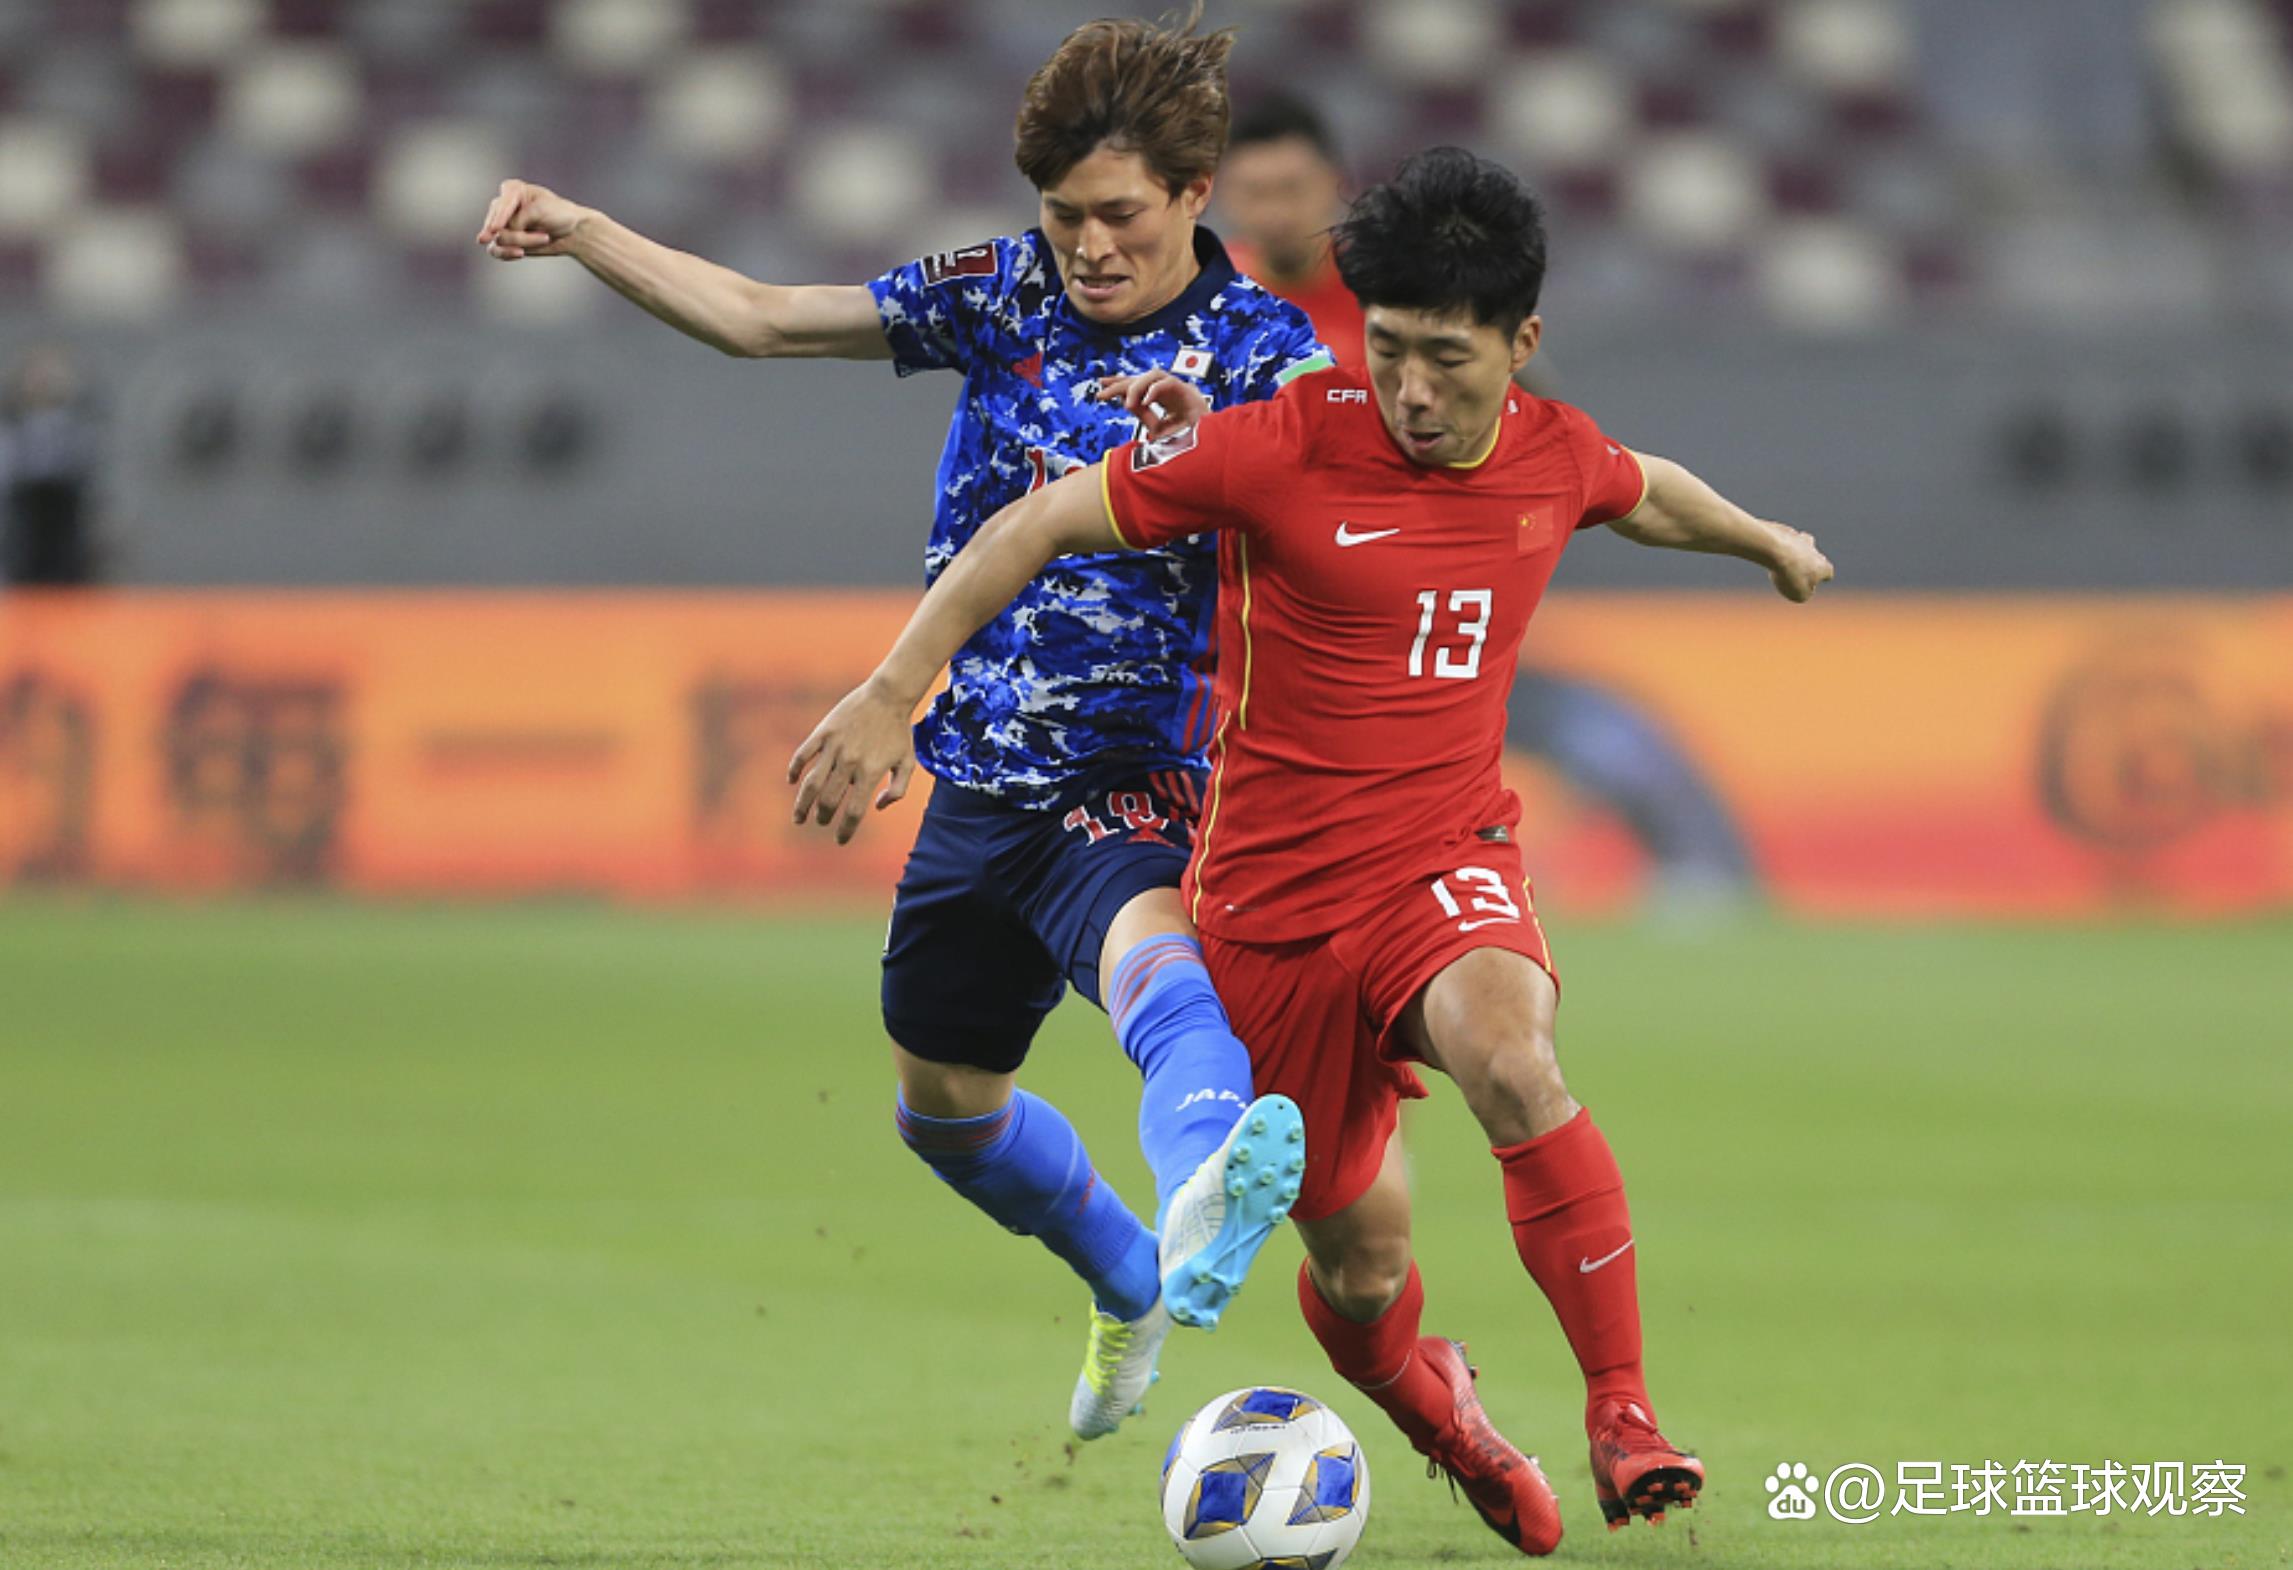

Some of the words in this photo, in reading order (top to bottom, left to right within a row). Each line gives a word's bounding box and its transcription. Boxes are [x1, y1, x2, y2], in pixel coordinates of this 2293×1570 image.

[1408, 588, 1493, 679] 13
[1430, 866, 1520, 919] 13
[1175, 1087, 1248, 1112] JAP
